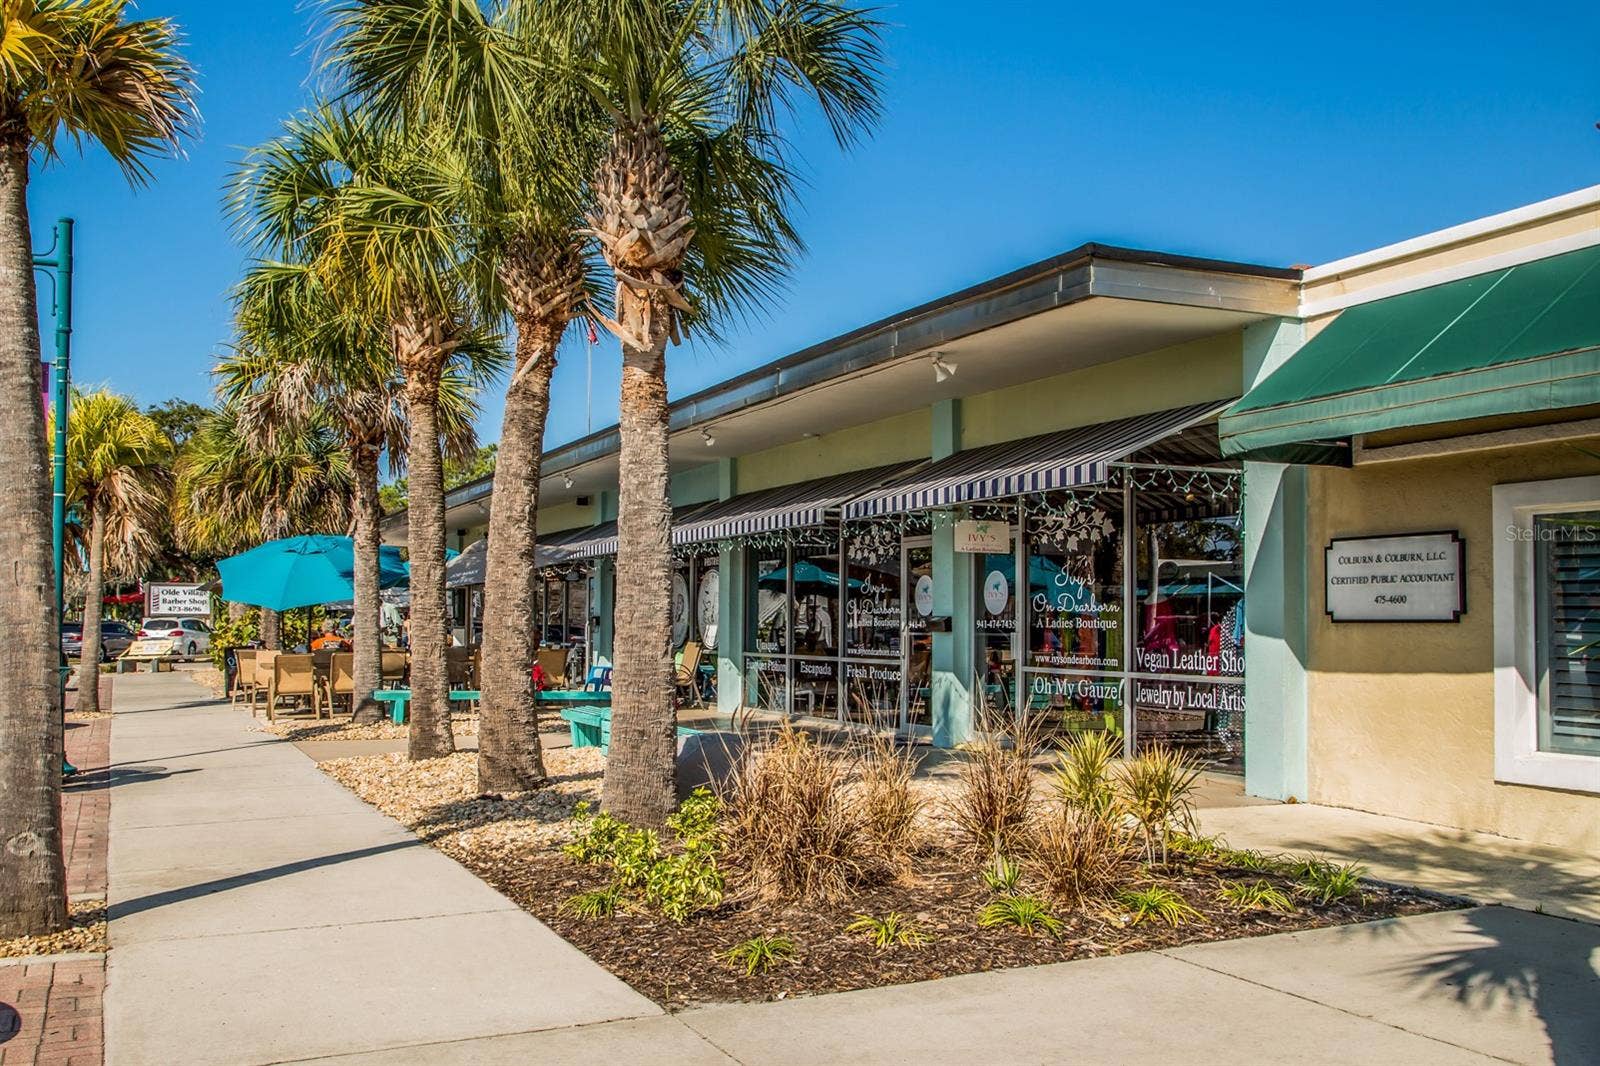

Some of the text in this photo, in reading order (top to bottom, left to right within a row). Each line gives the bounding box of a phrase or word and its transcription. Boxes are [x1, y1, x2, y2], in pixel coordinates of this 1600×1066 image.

[968, 533, 996, 542] IVY'S
[1337, 554, 1373, 565] COLBURN
[1375, 553, 1382, 563] &
[1330, 573, 1455, 585] CERTIFIED PUBLIC ACCOUNTANT
[182, 589, 208, 597] Village
[1374, 595, 1407, 605] 475-4600
[188, 598, 207, 606] Shop
[1032, 593, 1120, 613] On Dearborn
[1036, 617, 1118, 631] A Ladies Boutique
[1034, 653, 1119, 667] www.ivysondearborn.com
[1135, 647, 1246, 673] Vegan Leather Sho
[800, 661, 832, 676] Escapada
[846, 664, 901, 681] Fresh Produce
[1034, 676, 1125, 706] Oh My Gauze!
[1135, 682, 1247, 711] Jewelry by Local Artis
